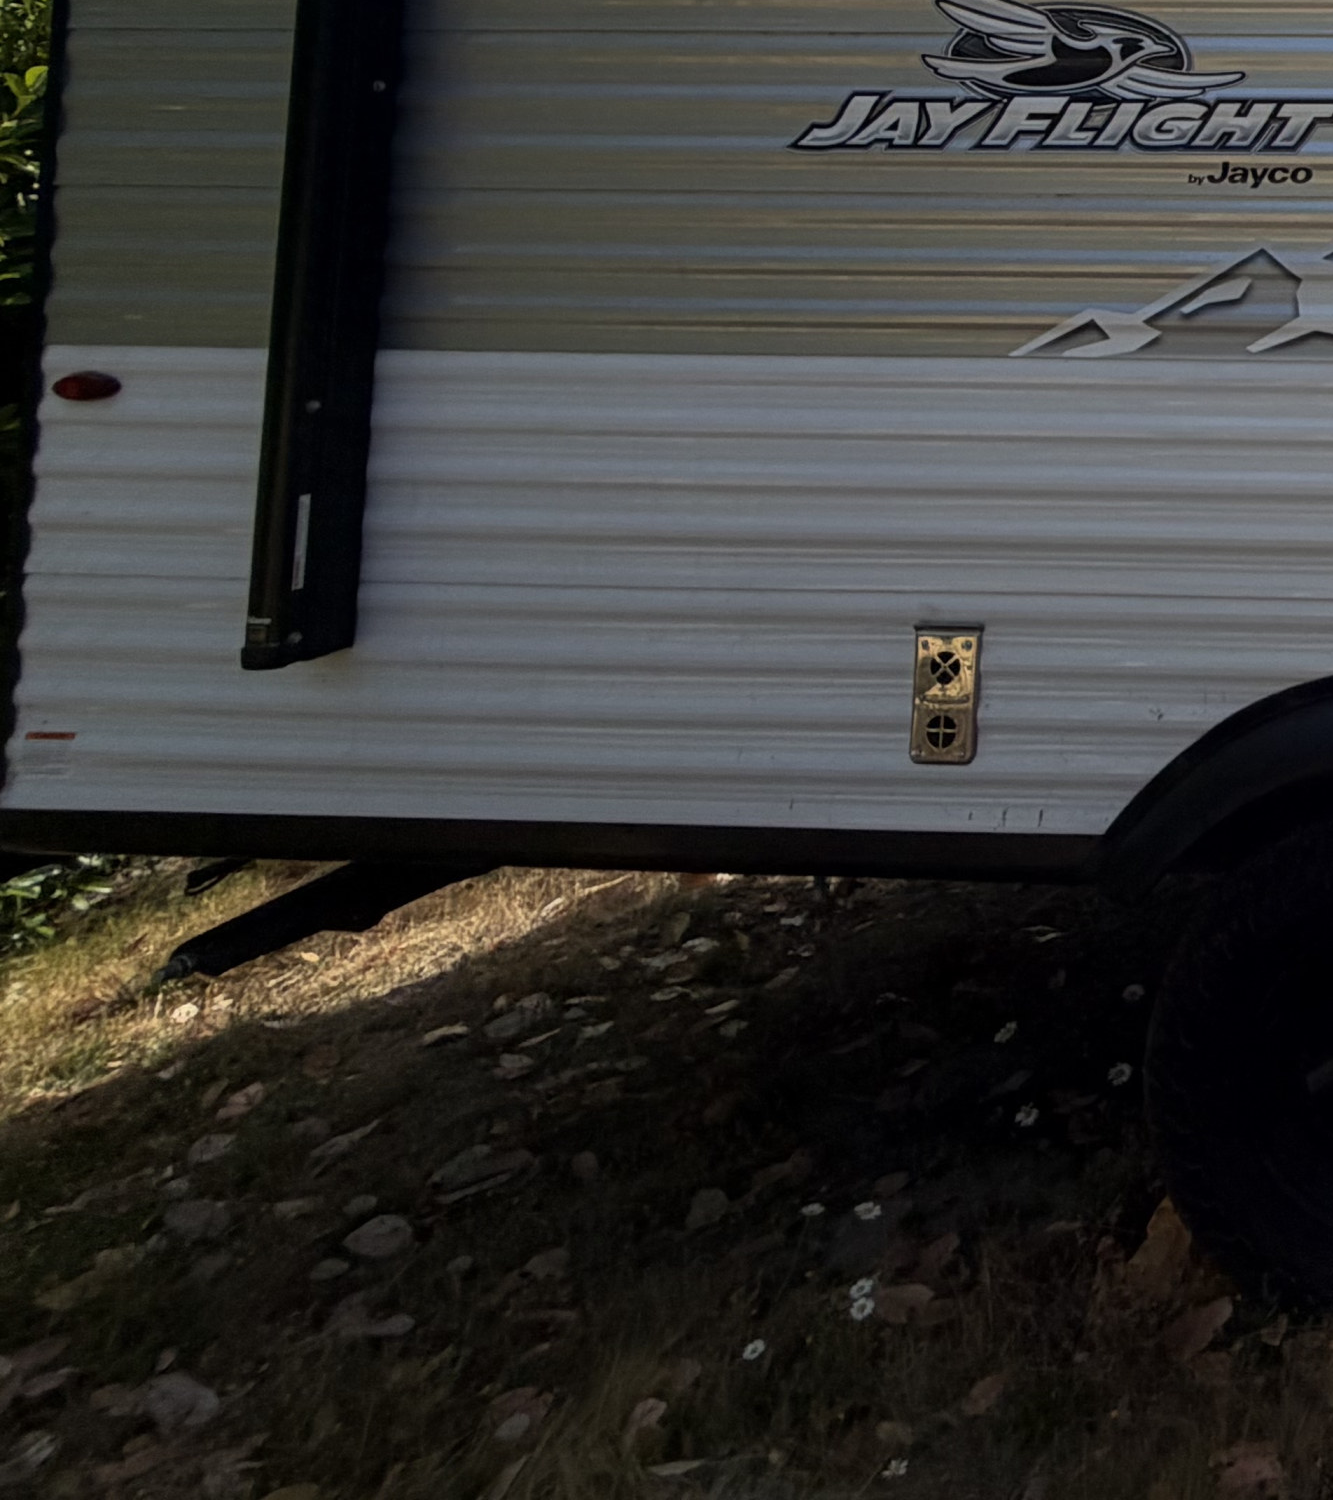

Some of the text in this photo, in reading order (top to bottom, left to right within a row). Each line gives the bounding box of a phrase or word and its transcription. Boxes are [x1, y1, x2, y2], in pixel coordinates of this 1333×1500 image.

[789, 89, 996, 153] JAY
[1188, 161, 1313, 188] by Jayco
